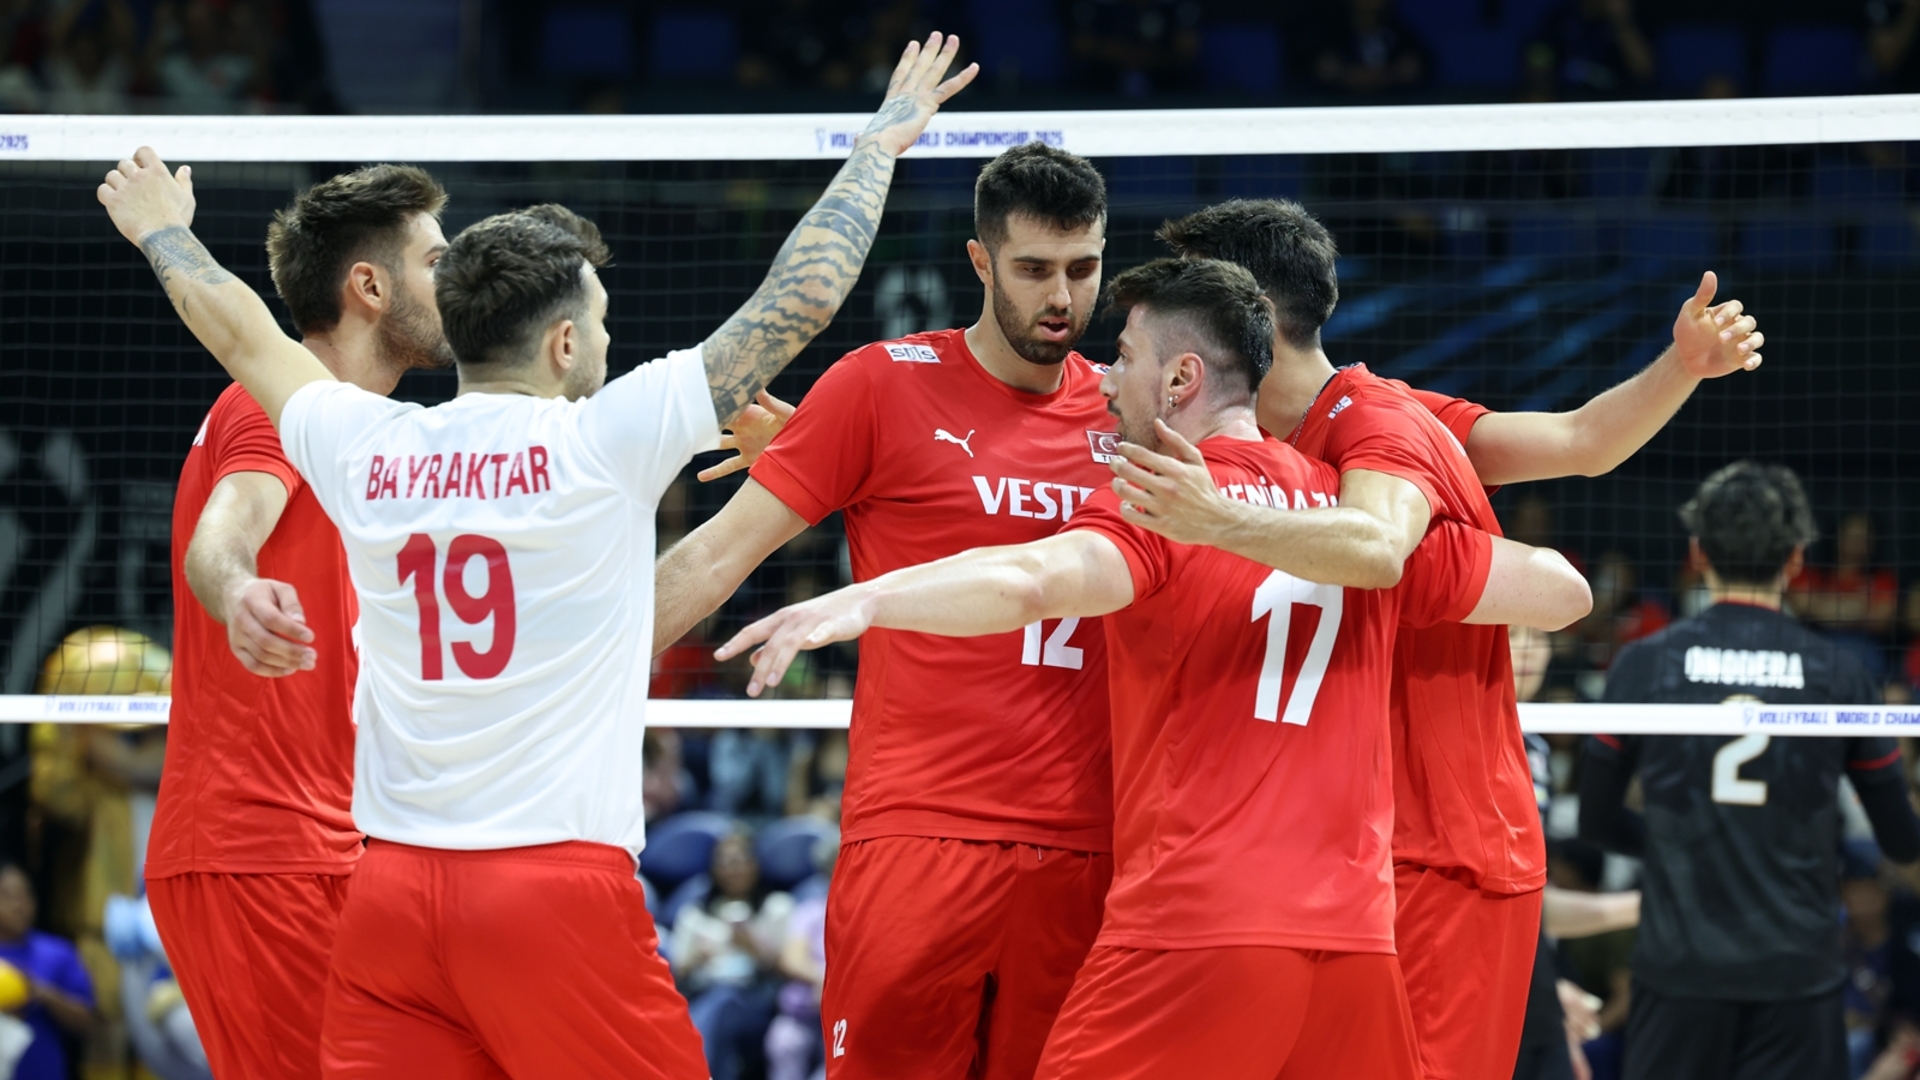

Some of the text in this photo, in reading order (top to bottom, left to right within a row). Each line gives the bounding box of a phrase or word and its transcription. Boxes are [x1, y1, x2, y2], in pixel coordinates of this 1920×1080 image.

[366, 445, 551, 501] BAYRAKTAR
[396, 533, 516, 681] 19
[1251, 568, 1344, 727] 17
[1684, 645, 1805, 690] ONODERA
[1759, 711, 1828, 724] VOLLEYBALL
[1836, 711, 1880, 724] WORLD
[1711, 694, 1772, 806] 2
[833, 1018, 847, 1059] 12
